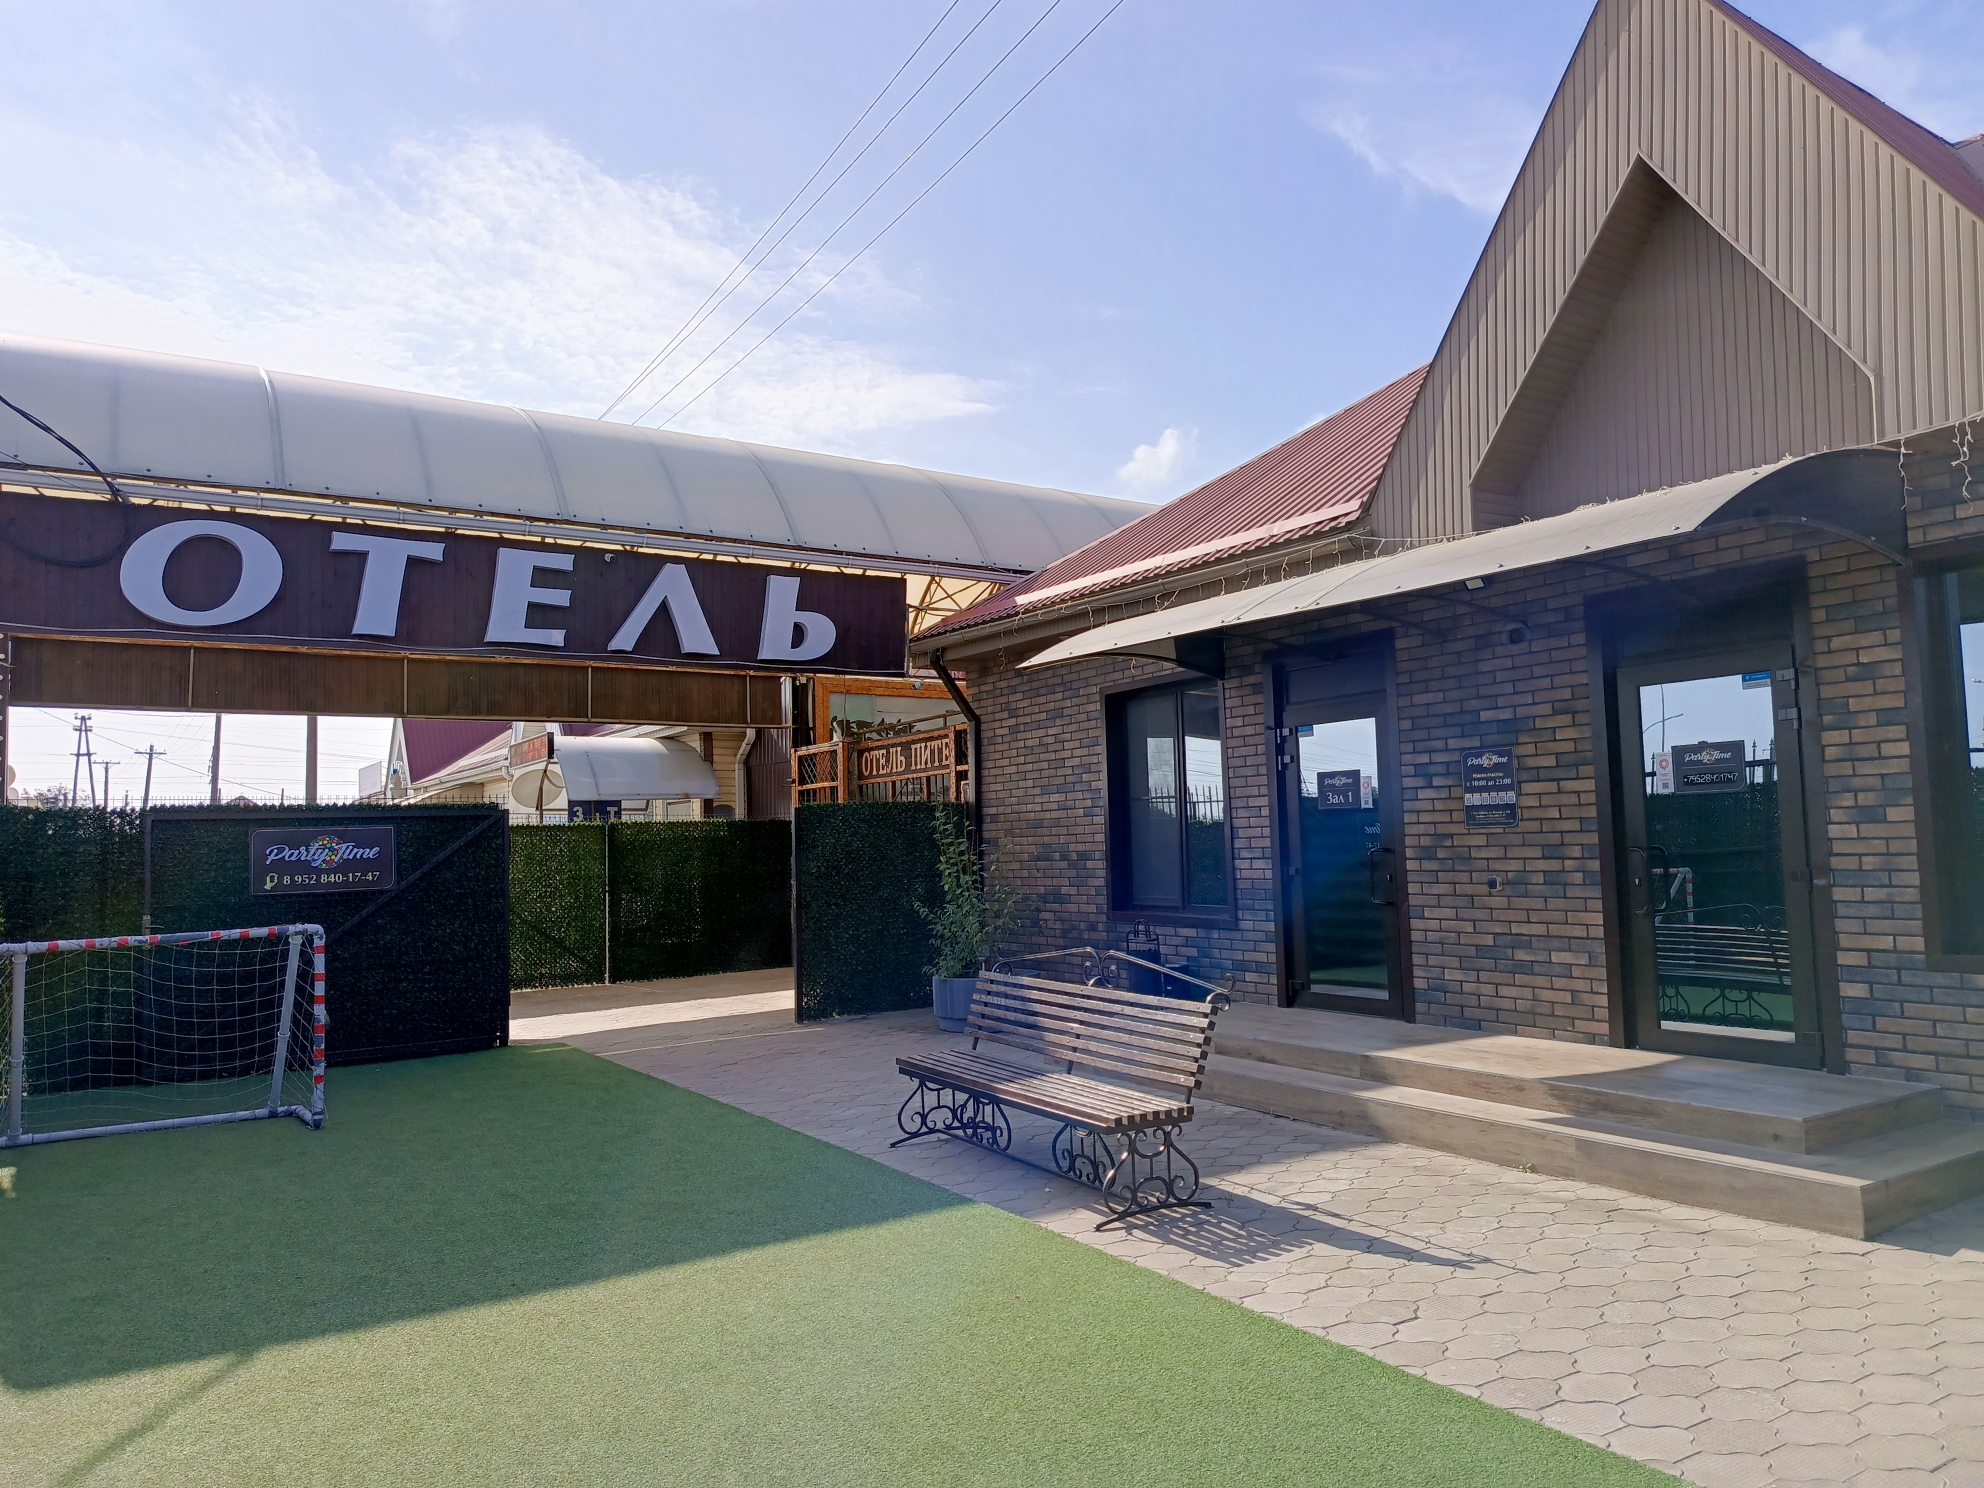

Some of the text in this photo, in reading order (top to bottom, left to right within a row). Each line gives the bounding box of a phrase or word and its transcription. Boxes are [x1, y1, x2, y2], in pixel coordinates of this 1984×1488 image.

[119, 519, 838, 661] ОТЕЛЬ
[862, 746, 906, 776] ОТЕЛЬ
[1467, 754, 1508, 767] Party Time
[1684, 750, 1732, 763] Party Time
[1326, 791, 1353, 804] Зал 1
[265, 842, 381, 867] Party Time
[283, 871, 380, 885] 8 952 840-17-47
